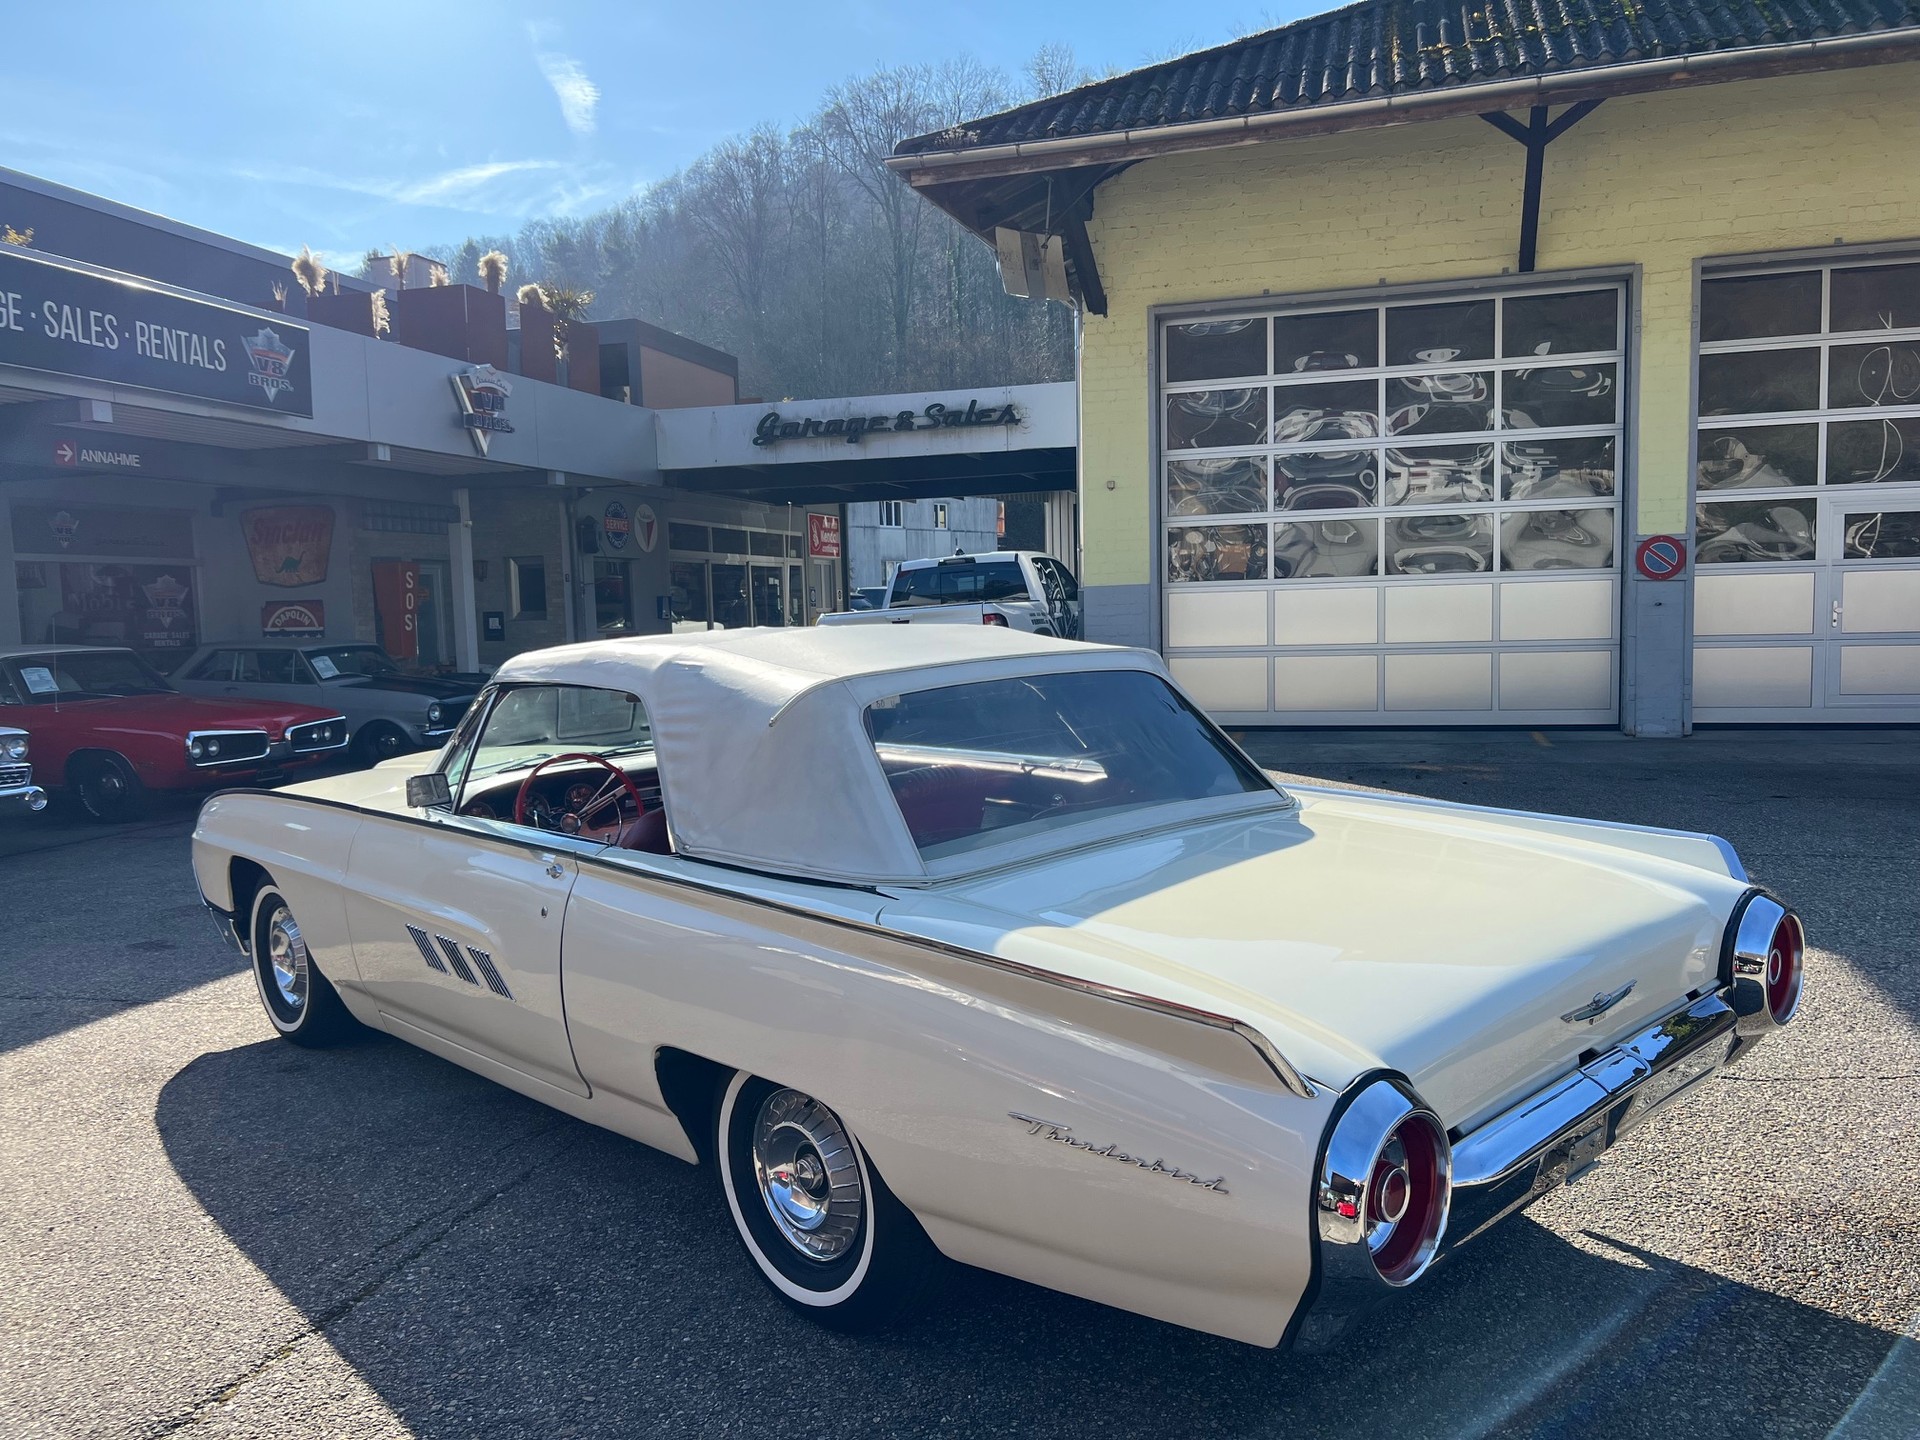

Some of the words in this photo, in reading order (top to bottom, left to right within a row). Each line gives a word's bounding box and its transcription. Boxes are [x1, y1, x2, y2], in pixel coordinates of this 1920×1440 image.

[43, 300, 119, 350] SALES
[135, 320, 227, 372] RENTALS
[256, 357, 285, 376] V8
[752, 411, 891, 446] Garage
[893, 410, 914, 431] &
[917, 399, 1021, 430] Sales
[81, 449, 141, 467] ANNAHME
[606, 519, 628, 531] SERVICE
[274, 610, 311, 627] DAPOLIN
[1007, 1111, 1230, 1195] Thunderbird
